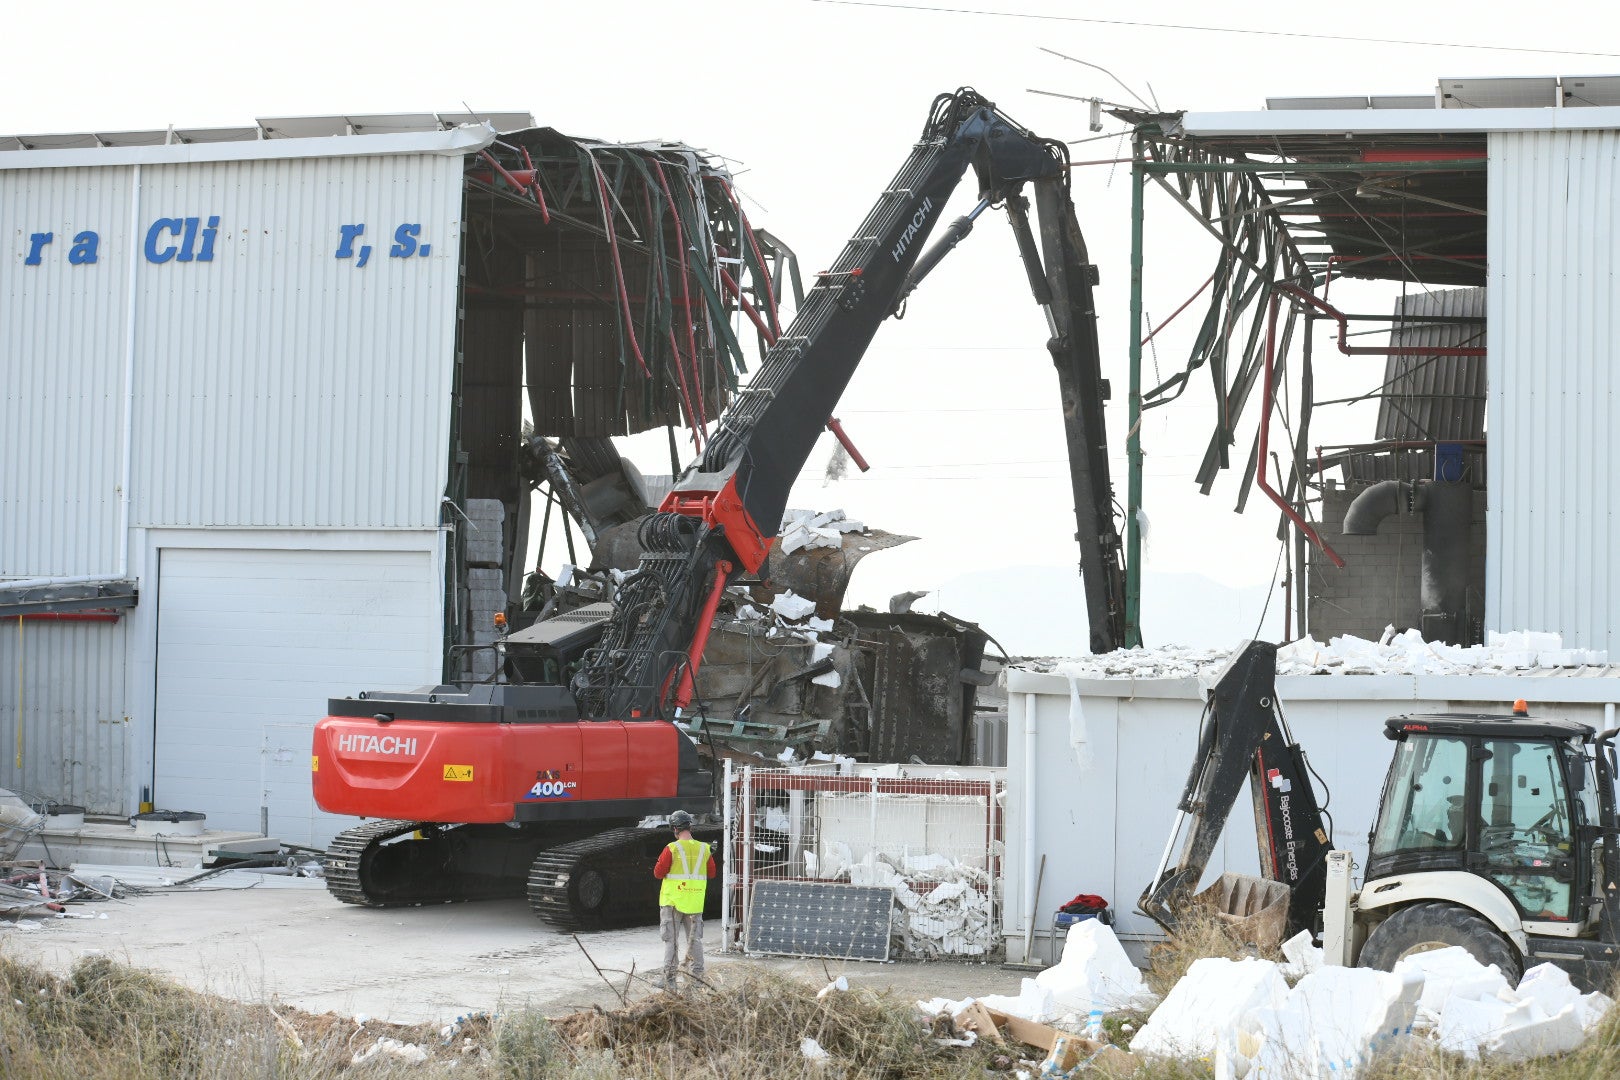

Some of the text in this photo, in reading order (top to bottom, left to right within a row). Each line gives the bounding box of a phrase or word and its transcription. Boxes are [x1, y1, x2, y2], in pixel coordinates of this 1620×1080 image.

[144, 215, 220, 264] Cli
[892, 196, 933, 263] HITACHI
[338, 734, 417, 756] HITACHI
[1279, 795, 1293, 840] Bajocoste
